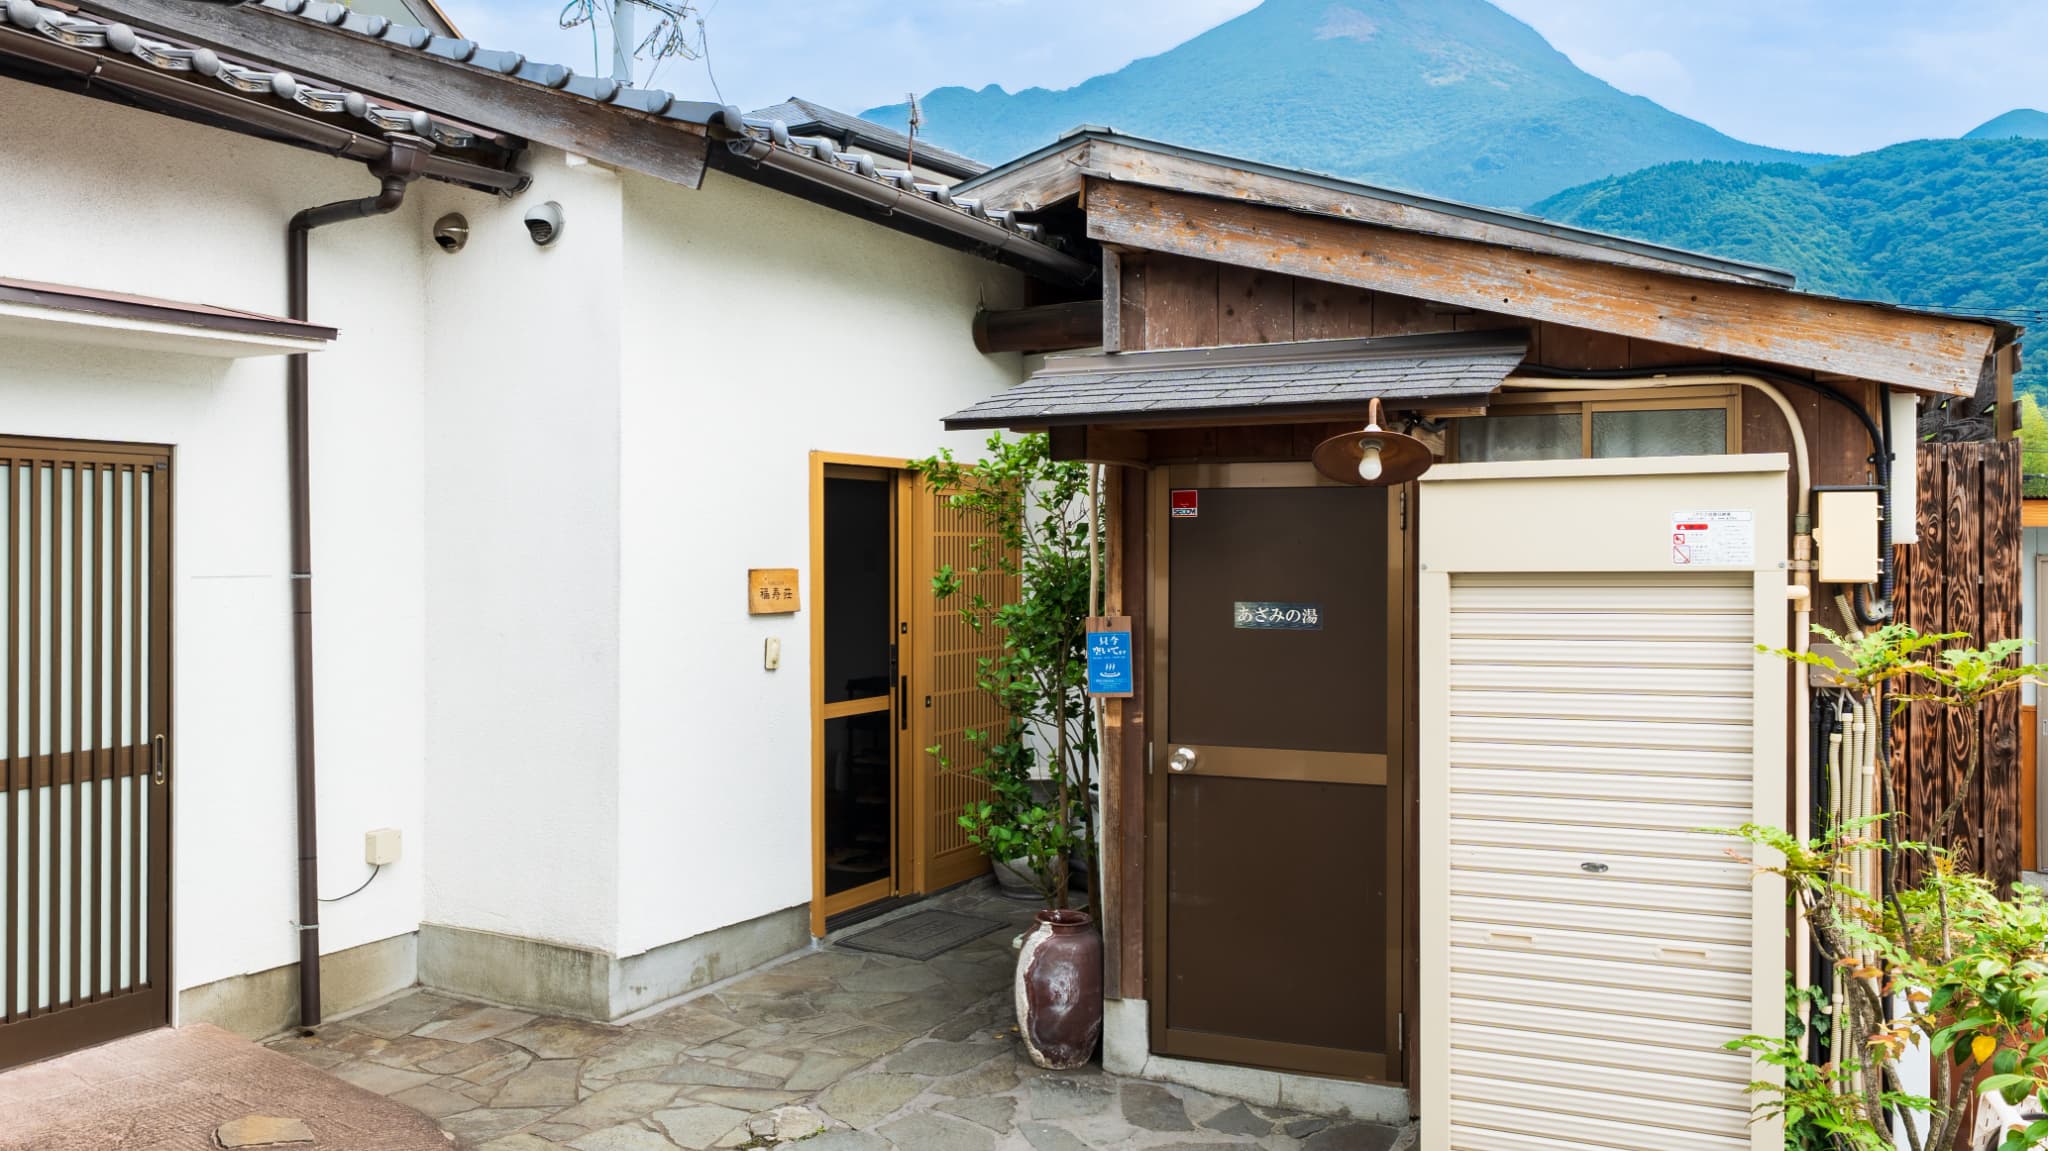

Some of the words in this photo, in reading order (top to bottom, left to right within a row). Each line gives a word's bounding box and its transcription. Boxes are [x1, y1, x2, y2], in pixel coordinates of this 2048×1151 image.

[760, 588, 792, 600] 福寿荘
[1238, 606, 1318, 624] あざみの湯
